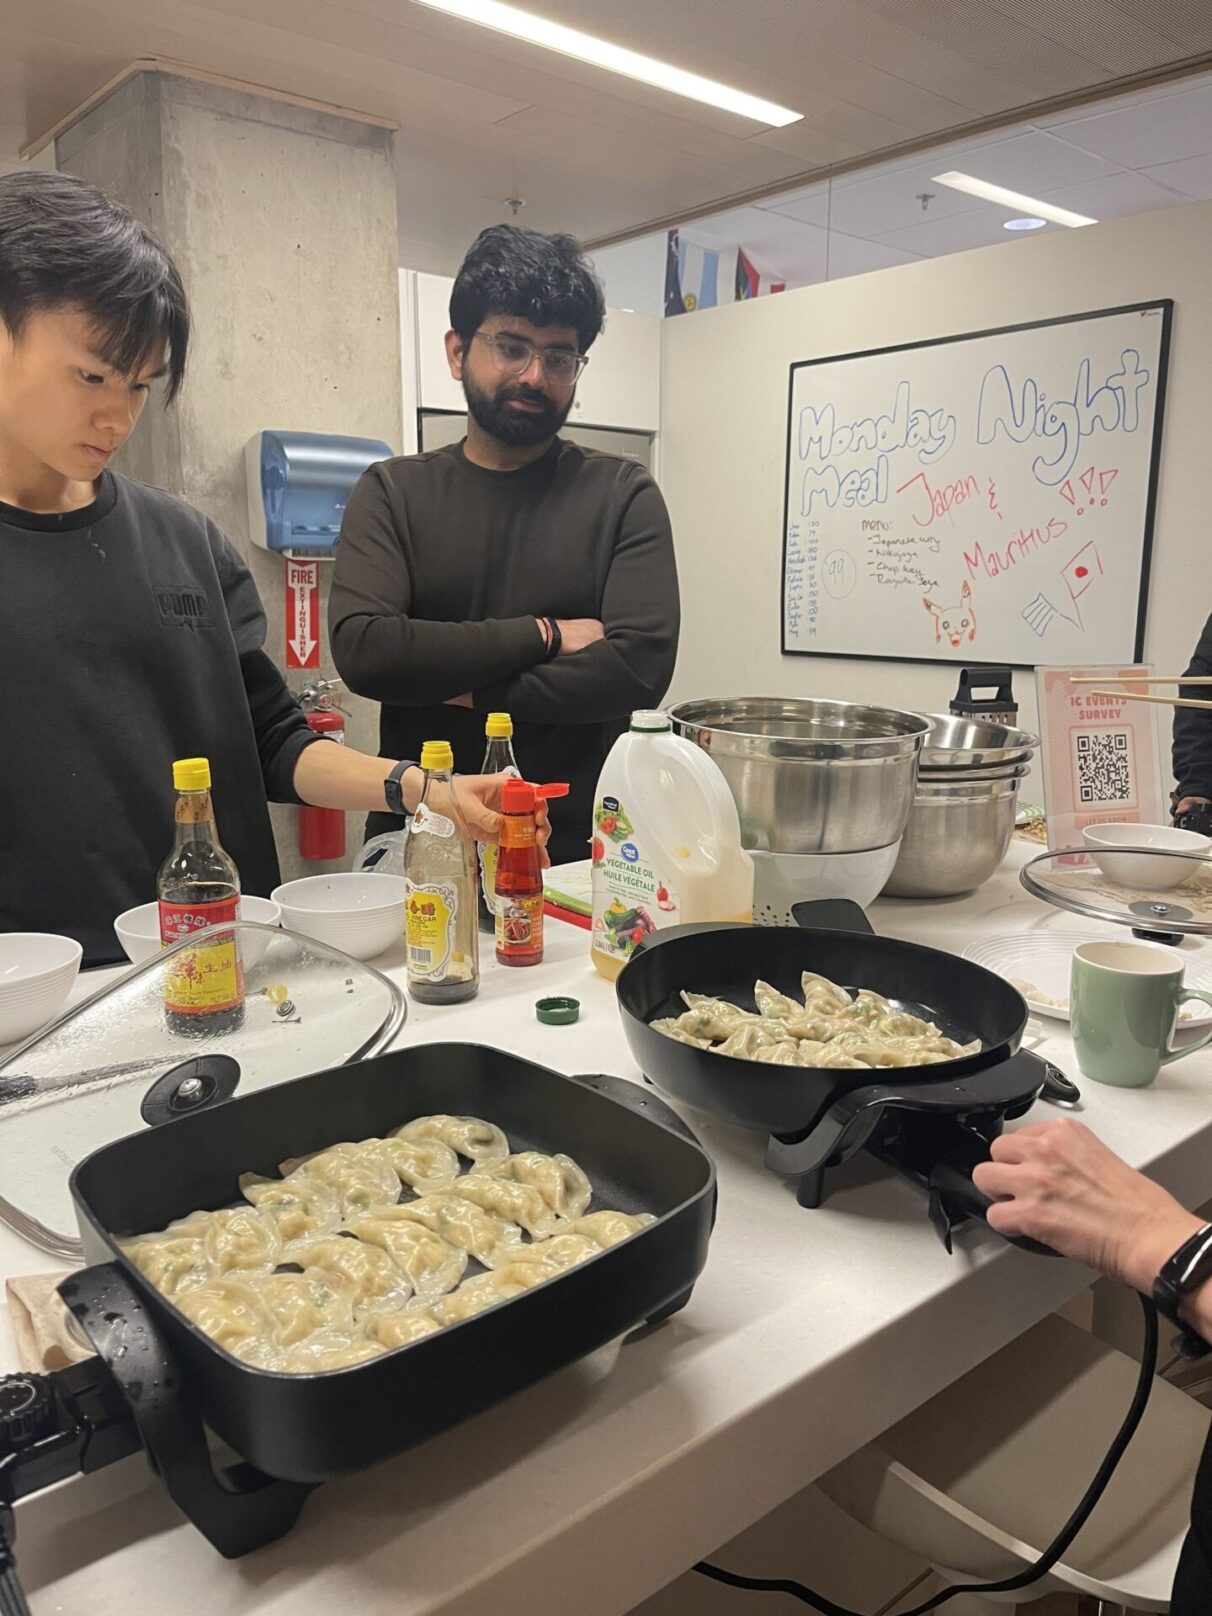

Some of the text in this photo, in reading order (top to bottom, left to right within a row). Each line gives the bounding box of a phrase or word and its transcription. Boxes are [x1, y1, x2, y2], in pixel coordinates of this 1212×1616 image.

[799, 349, 1150, 486] Monday Night
[800, 455, 889, 517] Meal
[896, 472, 980, 526] Japan
[291, 569, 314, 585] FIRE
[1070, 696, 1082, 707] IC
[1078, 709, 1122, 720] SURVEY
[603, 869, 623, 882] HUILE
[606, 857, 655, 879] VEGETABLE OIL
